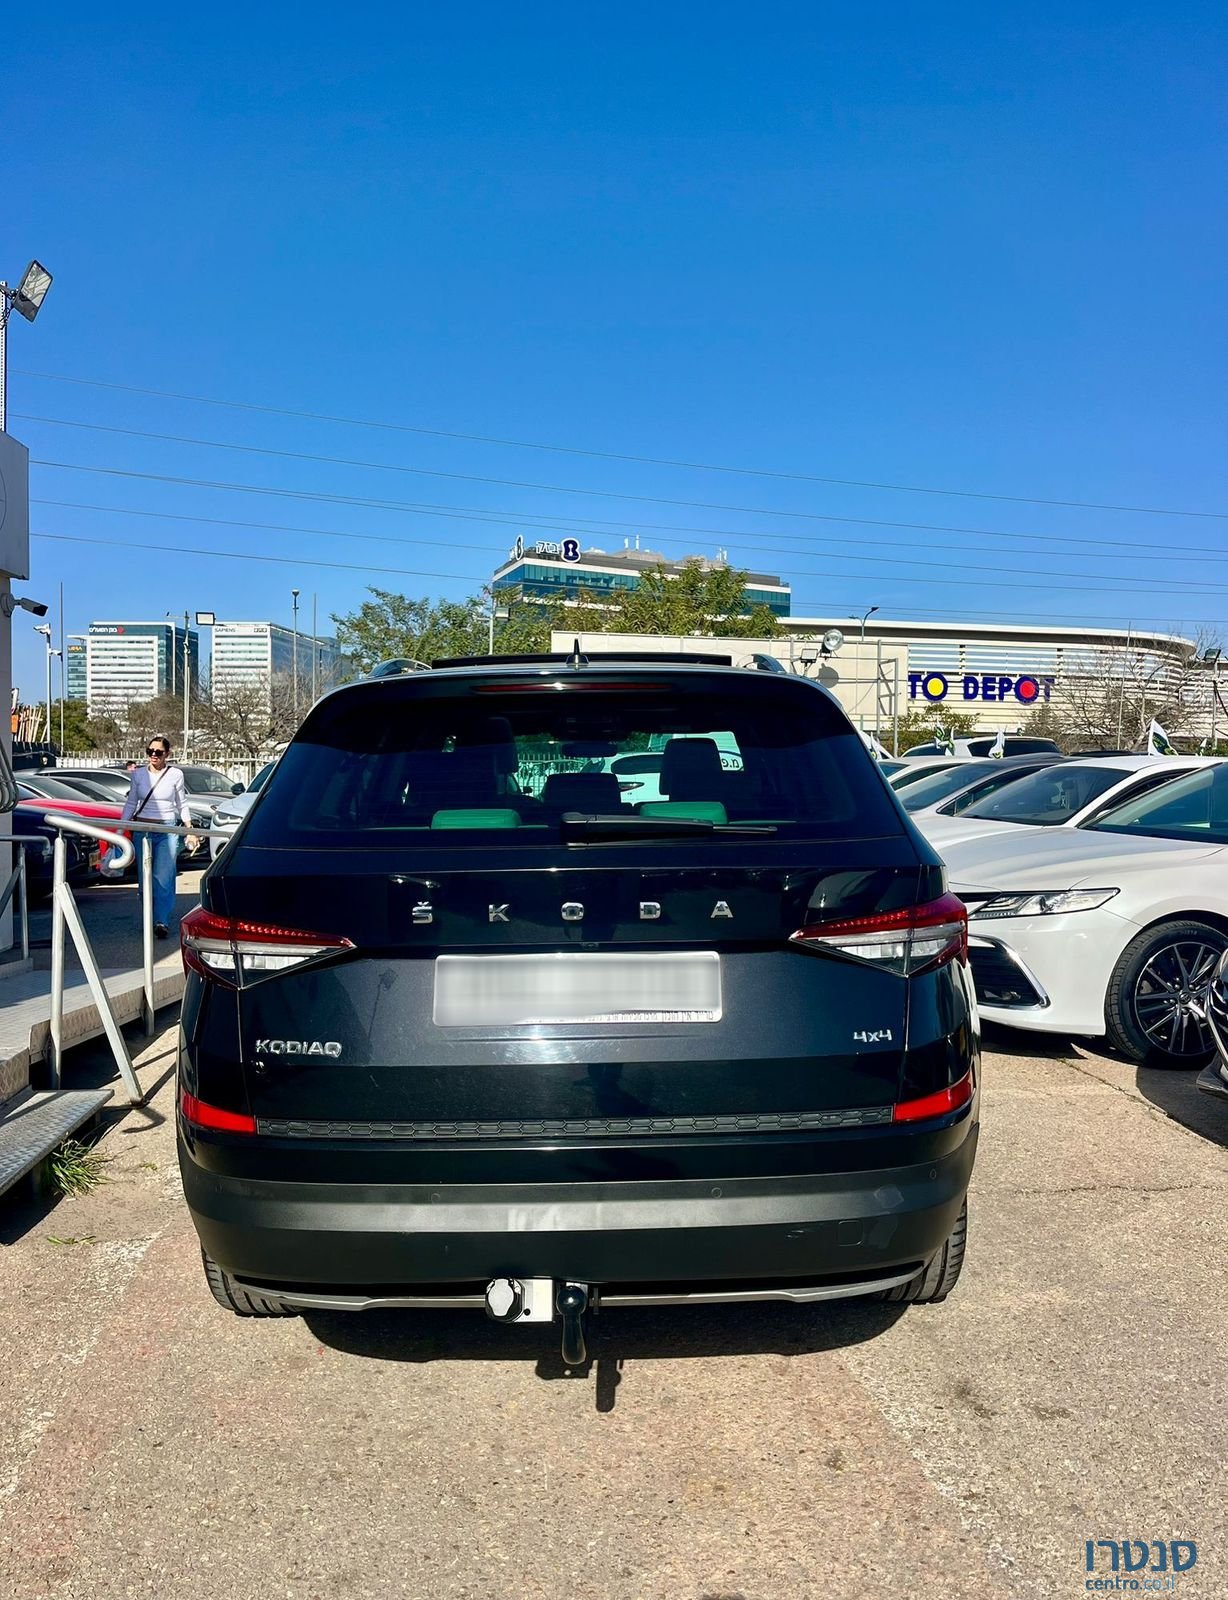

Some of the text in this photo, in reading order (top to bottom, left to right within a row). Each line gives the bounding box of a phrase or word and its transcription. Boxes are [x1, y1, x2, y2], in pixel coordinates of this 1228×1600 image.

[963, 674, 1055, 706] DEPOT
[412, 901, 733, 923] ŠKODA
[853, 1029, 892, 1042] 4x4
[256, 1039, 342, 1058] KODIAQ
